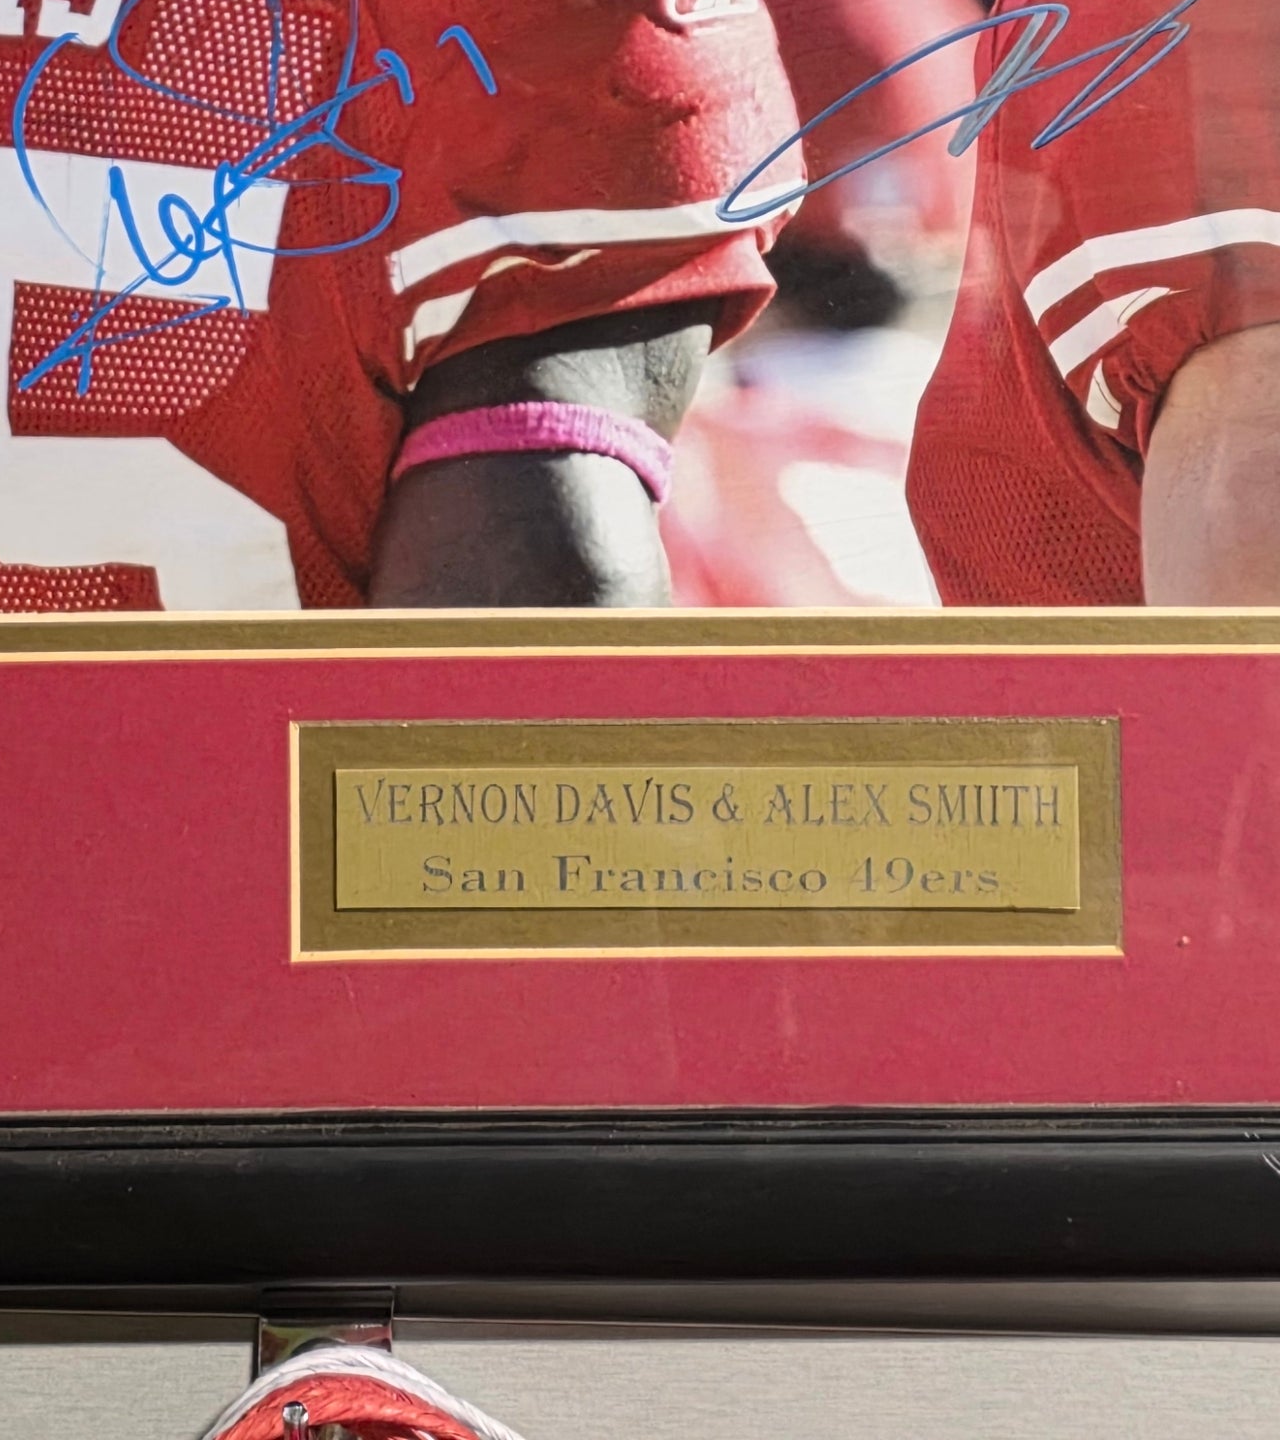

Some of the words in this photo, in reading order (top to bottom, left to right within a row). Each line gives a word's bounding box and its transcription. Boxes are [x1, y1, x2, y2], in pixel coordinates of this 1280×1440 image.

[354, 777, 538, 826] VERNON
[555, 777, 695, 825] DAVIS
[711, 782, 745, 824] &
[763, 783, 893, 827] ALEX
[422, 855, 526, 893] San
[552, 854, 828, 894] Francisco
[848, 856, 1001, 895] 49ers
